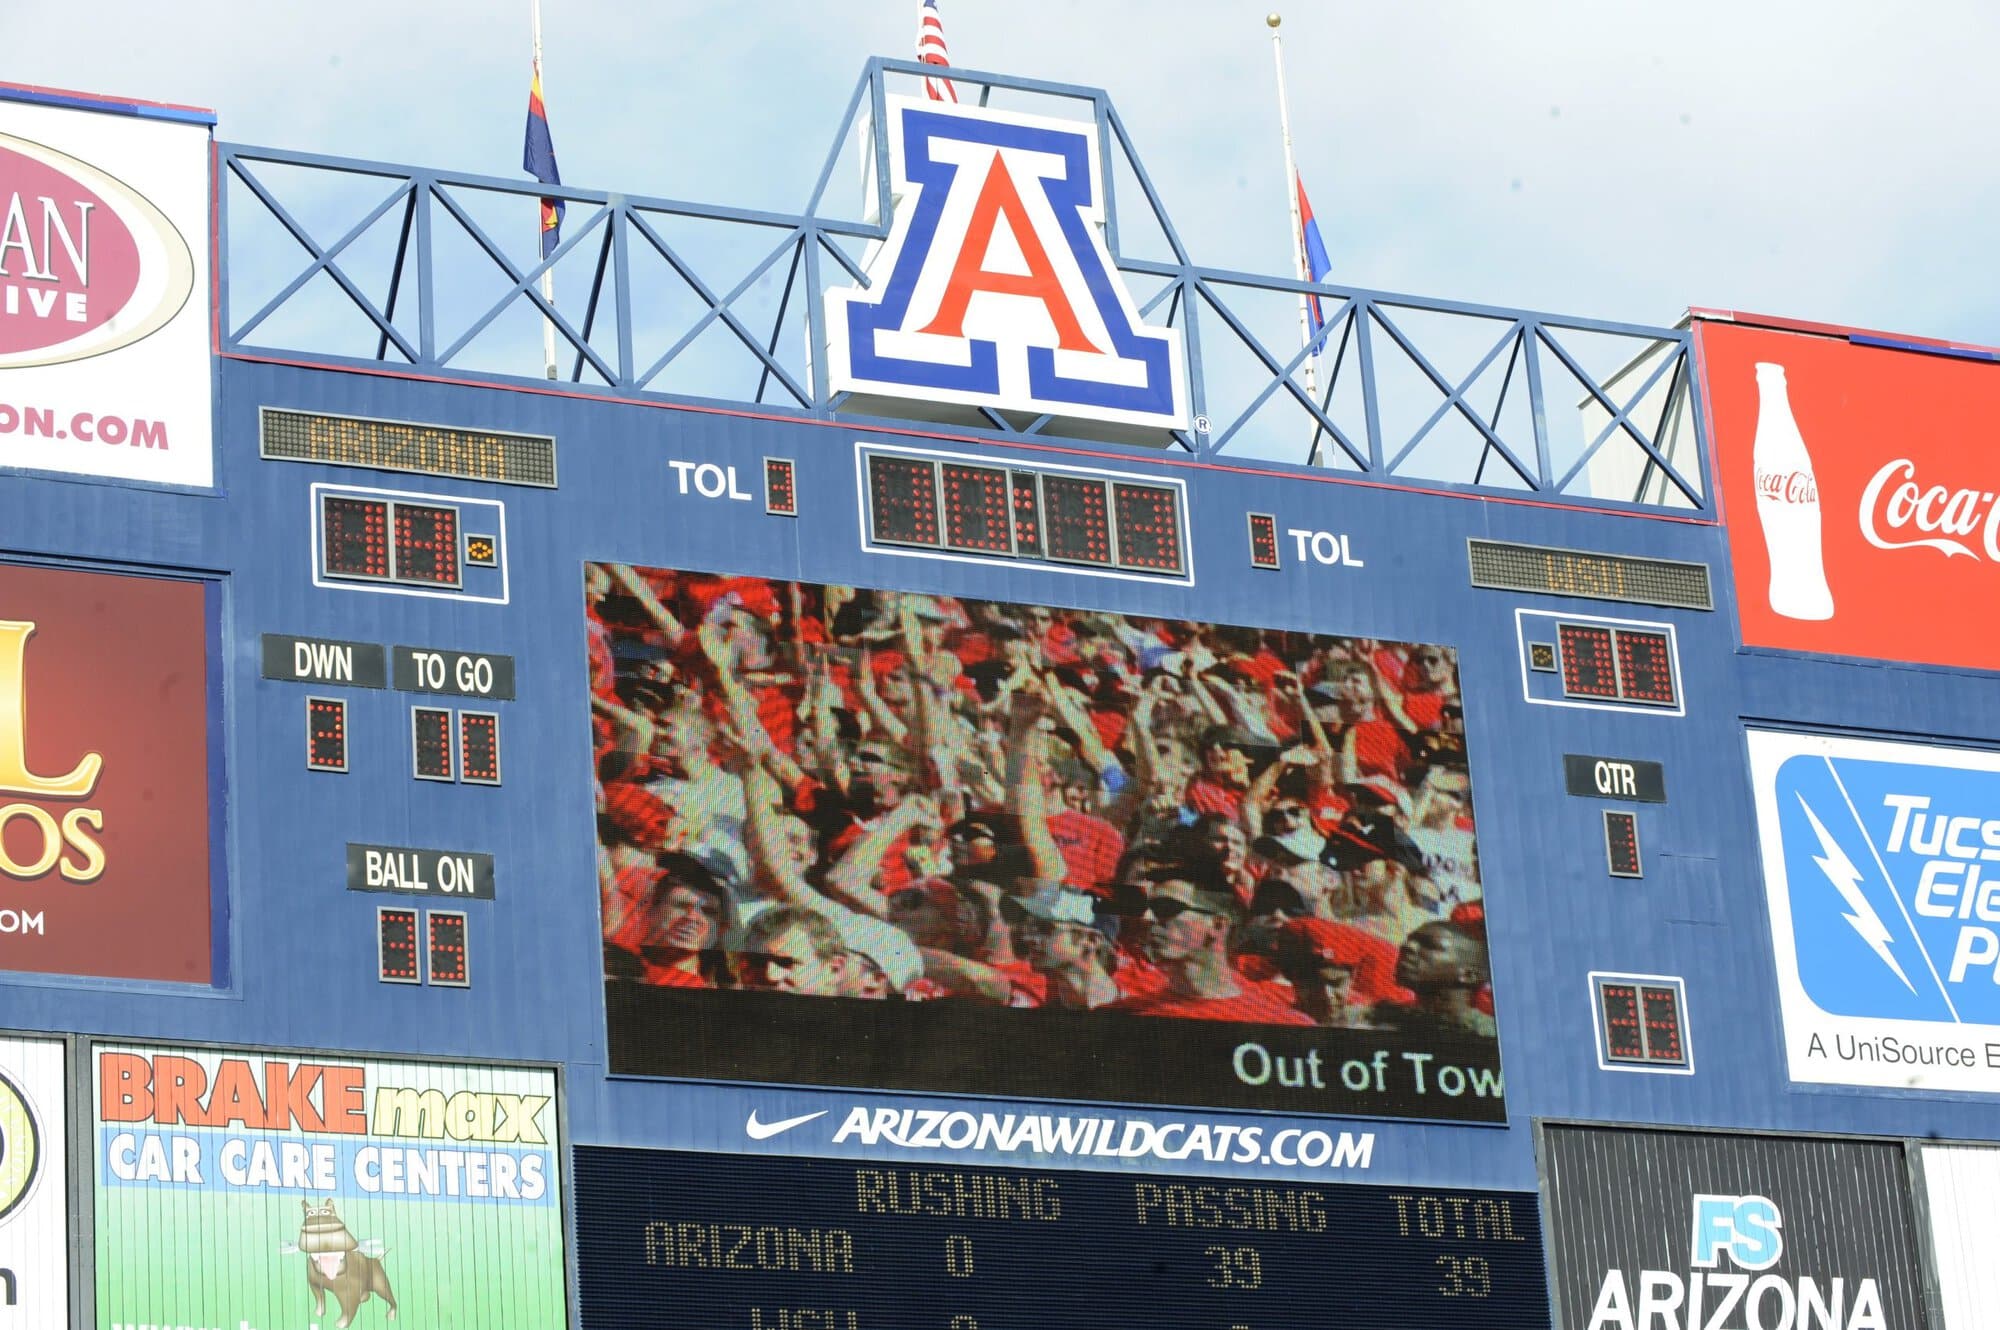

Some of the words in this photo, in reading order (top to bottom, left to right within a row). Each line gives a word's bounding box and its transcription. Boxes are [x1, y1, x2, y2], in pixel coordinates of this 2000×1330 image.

[0, 191, 95, 287] AN
[847, 108, 1175, 417] A
[6, 284, 88, 323] IVE
[0, 404, 169, 450] ON.COM
[310, 416, 505, 481] ARIZONA
[668, 460, 753, 501] TOL
[768, 464, 794, 511] 3
[1251, 518, 1275, 563] 3
[1287, 528, 1364, 567] TOL
[1545, 554, 1624, 597] WSU
[294, 641, 353, 682] DWN
[411, 652, 446, 690] TO
[455, 655, 494, 694] GO
[309, 703, 343, 766] 2
[439, 714, 497, 778] 10
[1594, 761, 1637, 796] QTR
[0, 803, 105, 881] OS
[365, 850, 428, 890] BALL
[437, 855, 475, 893] ON
[0, 909, 44, 935] OM
[381, 914, 464, 979] 35
[1948, 925, 2000, 986] P
[1232, 1042, 1326, 1089] Out
[1341, 1051, 1388, 1092] of
[1403, 1052, 1503, 1099] Tow
[1807, 1032, 1827, 1058] A
[1836, 1034, 1975, 1068] UniSource
[100, 1051, 367, 1135] BRAKE
[109, 1134, 205, 1185] CAR
[220, 1139, 338, 1191] CARE
[354, 1146, 546, 1200] CENTERS
[832, 1106, 1375, 1169] ARIZONAWILDCATS.COM
[857, 1169, 1061, 1221] RUSHING
[1135, 1183, 1327, 1233] PASSING
[1389, 1194, 1526, 1241] TOTAL
[1691, 1194, 1784, 1271] FS
[645, 1221, 854, 1273] ARIZONA
[1204, 1245, 1262, 1290] 39
[1435, 1254, 1492, 1298] 39
[1587, 1268, 1888, 1330] ARIZONA
